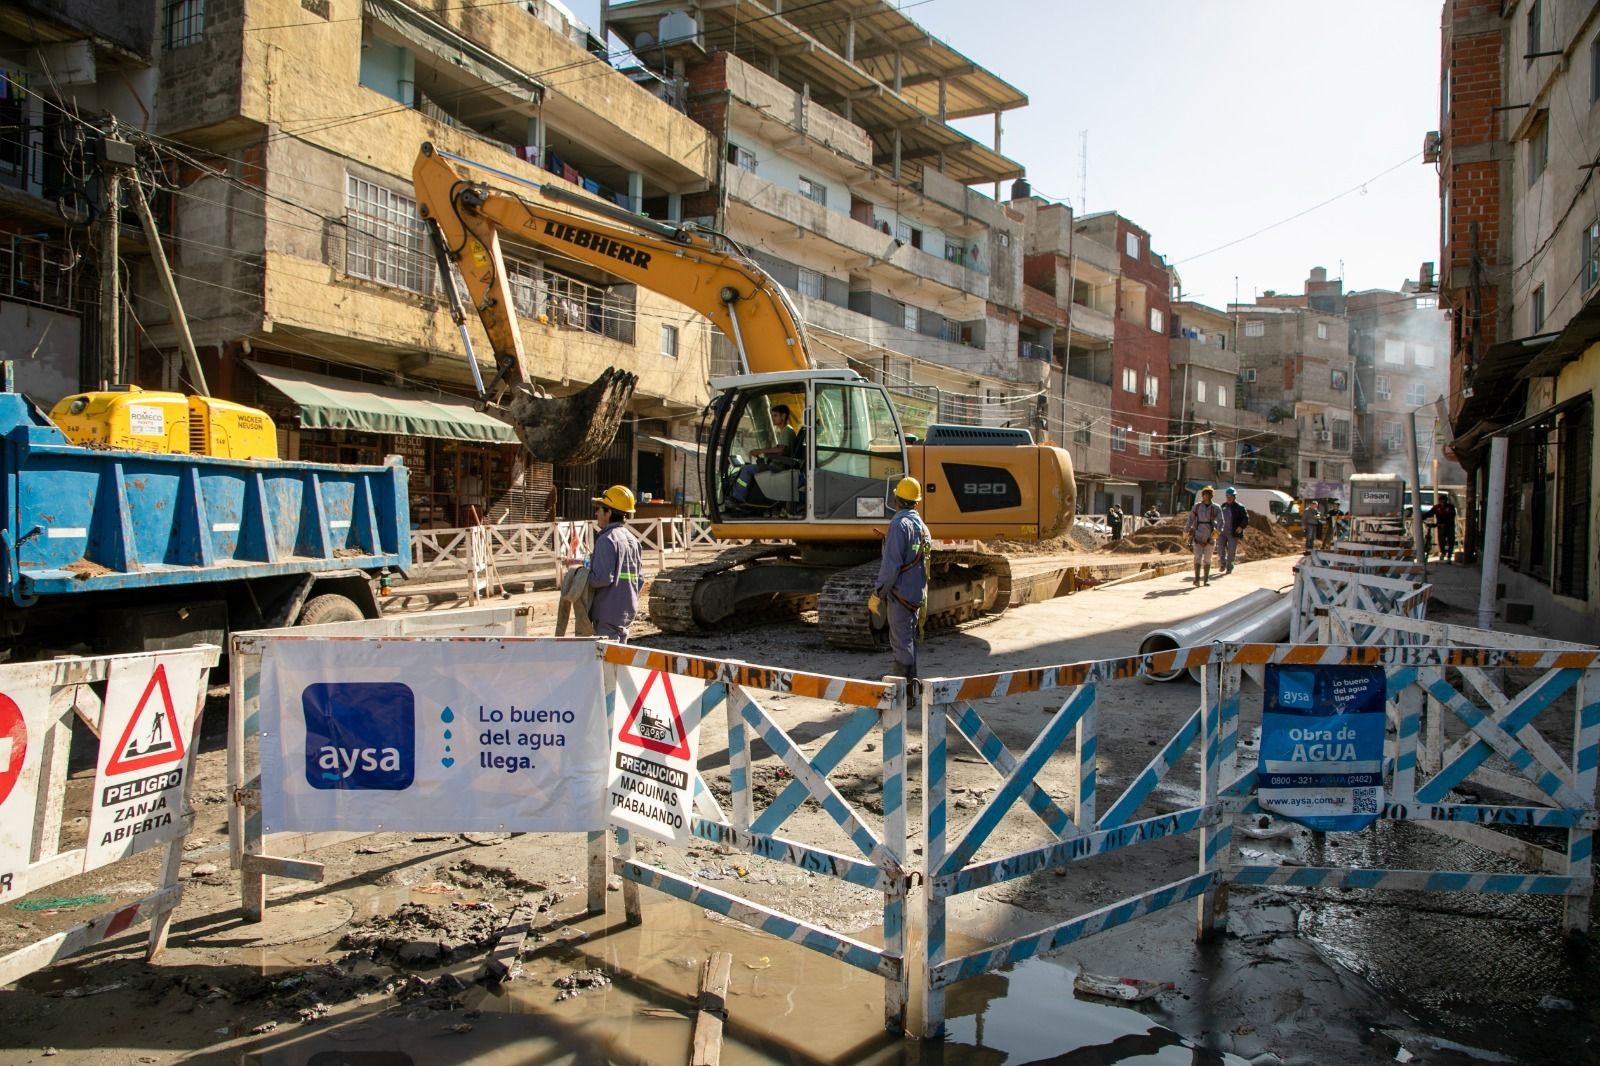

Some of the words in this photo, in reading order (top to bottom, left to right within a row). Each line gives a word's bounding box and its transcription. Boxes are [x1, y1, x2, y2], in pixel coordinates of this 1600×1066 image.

[543, 221, 652, 270] LIEBHERR
[131, 413, 163, 421] ROMECO
[237, 422, 263, 430] NEUSON
[394, 435, 422, 446] KIOSCO
[963, 483, 1007, 494] 920
[1343, 678, 1370, 686] bueno
[1347, 686, 1367, 695] agua
[1283, 690, 1310, 703] aysa
[1334, 693, 1357, 702] llega.
[479, 706, 503, 723] Lo
[510, 706, 575, 723] bueno
[479, 729, 510, 746] del
[518, 733, 565, 750] agua
[1289, 728, 1332, 741] Obra
[1336, 726, 1357, 740] de
[1291, 743, 1357, 761] AGUA
[319, 745, 400, 777] aysa
[480, 752, 536, 773] llega.
[620, 755, 684, 787] PRECAUCION
[106, 772, 181, 803] PELIGRO
[1271, 776, 1291, 785] 0800
[1298, 776, 1312, 784] 321
[620, 776, 678, 807] MAQUINAS
[113, 796, 167, 824] ZANJA
[1265, 796, 1346, 807] www.aysa.com.ar
[611, 792, 683, 829] TRABAJANDO
[101, 812, 172, 846] ABIERTA
[783, 844, 838, 876] AYSA
